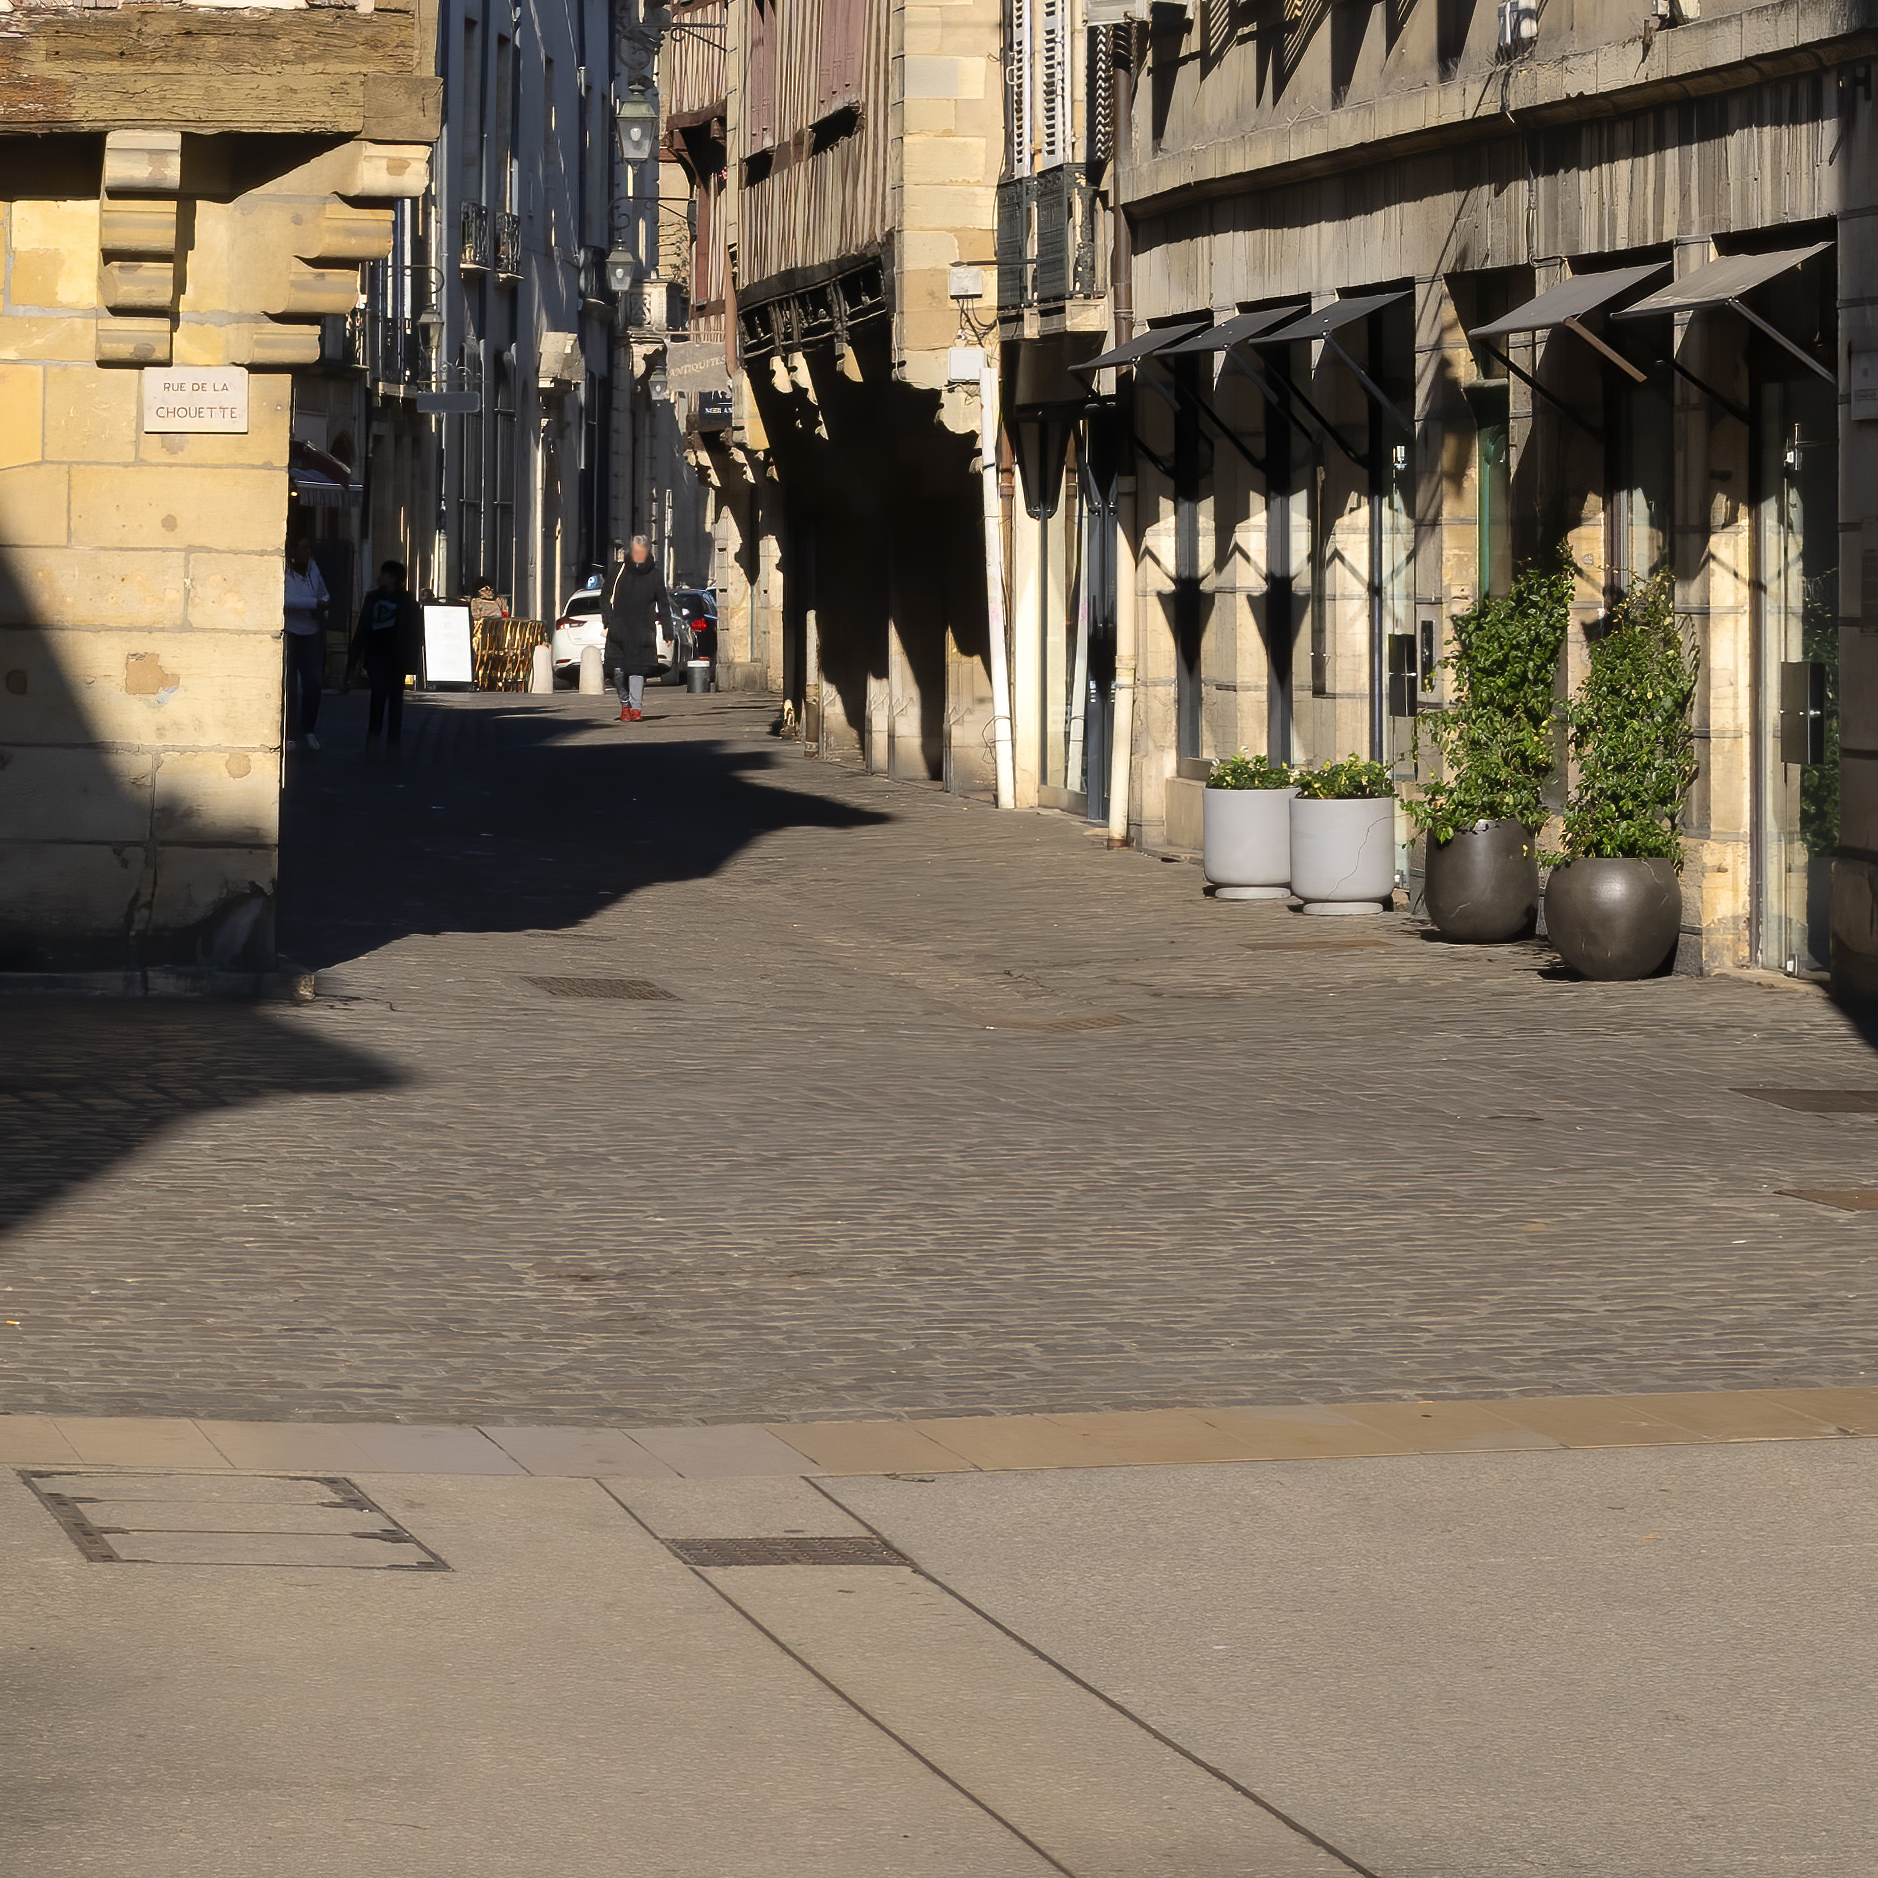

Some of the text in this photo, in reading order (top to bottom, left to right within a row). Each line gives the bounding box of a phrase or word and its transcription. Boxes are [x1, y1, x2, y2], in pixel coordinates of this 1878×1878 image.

[163, 382, 229, 392] RUE DE LA
[155, 406, 238, 419] CHOUETTE
